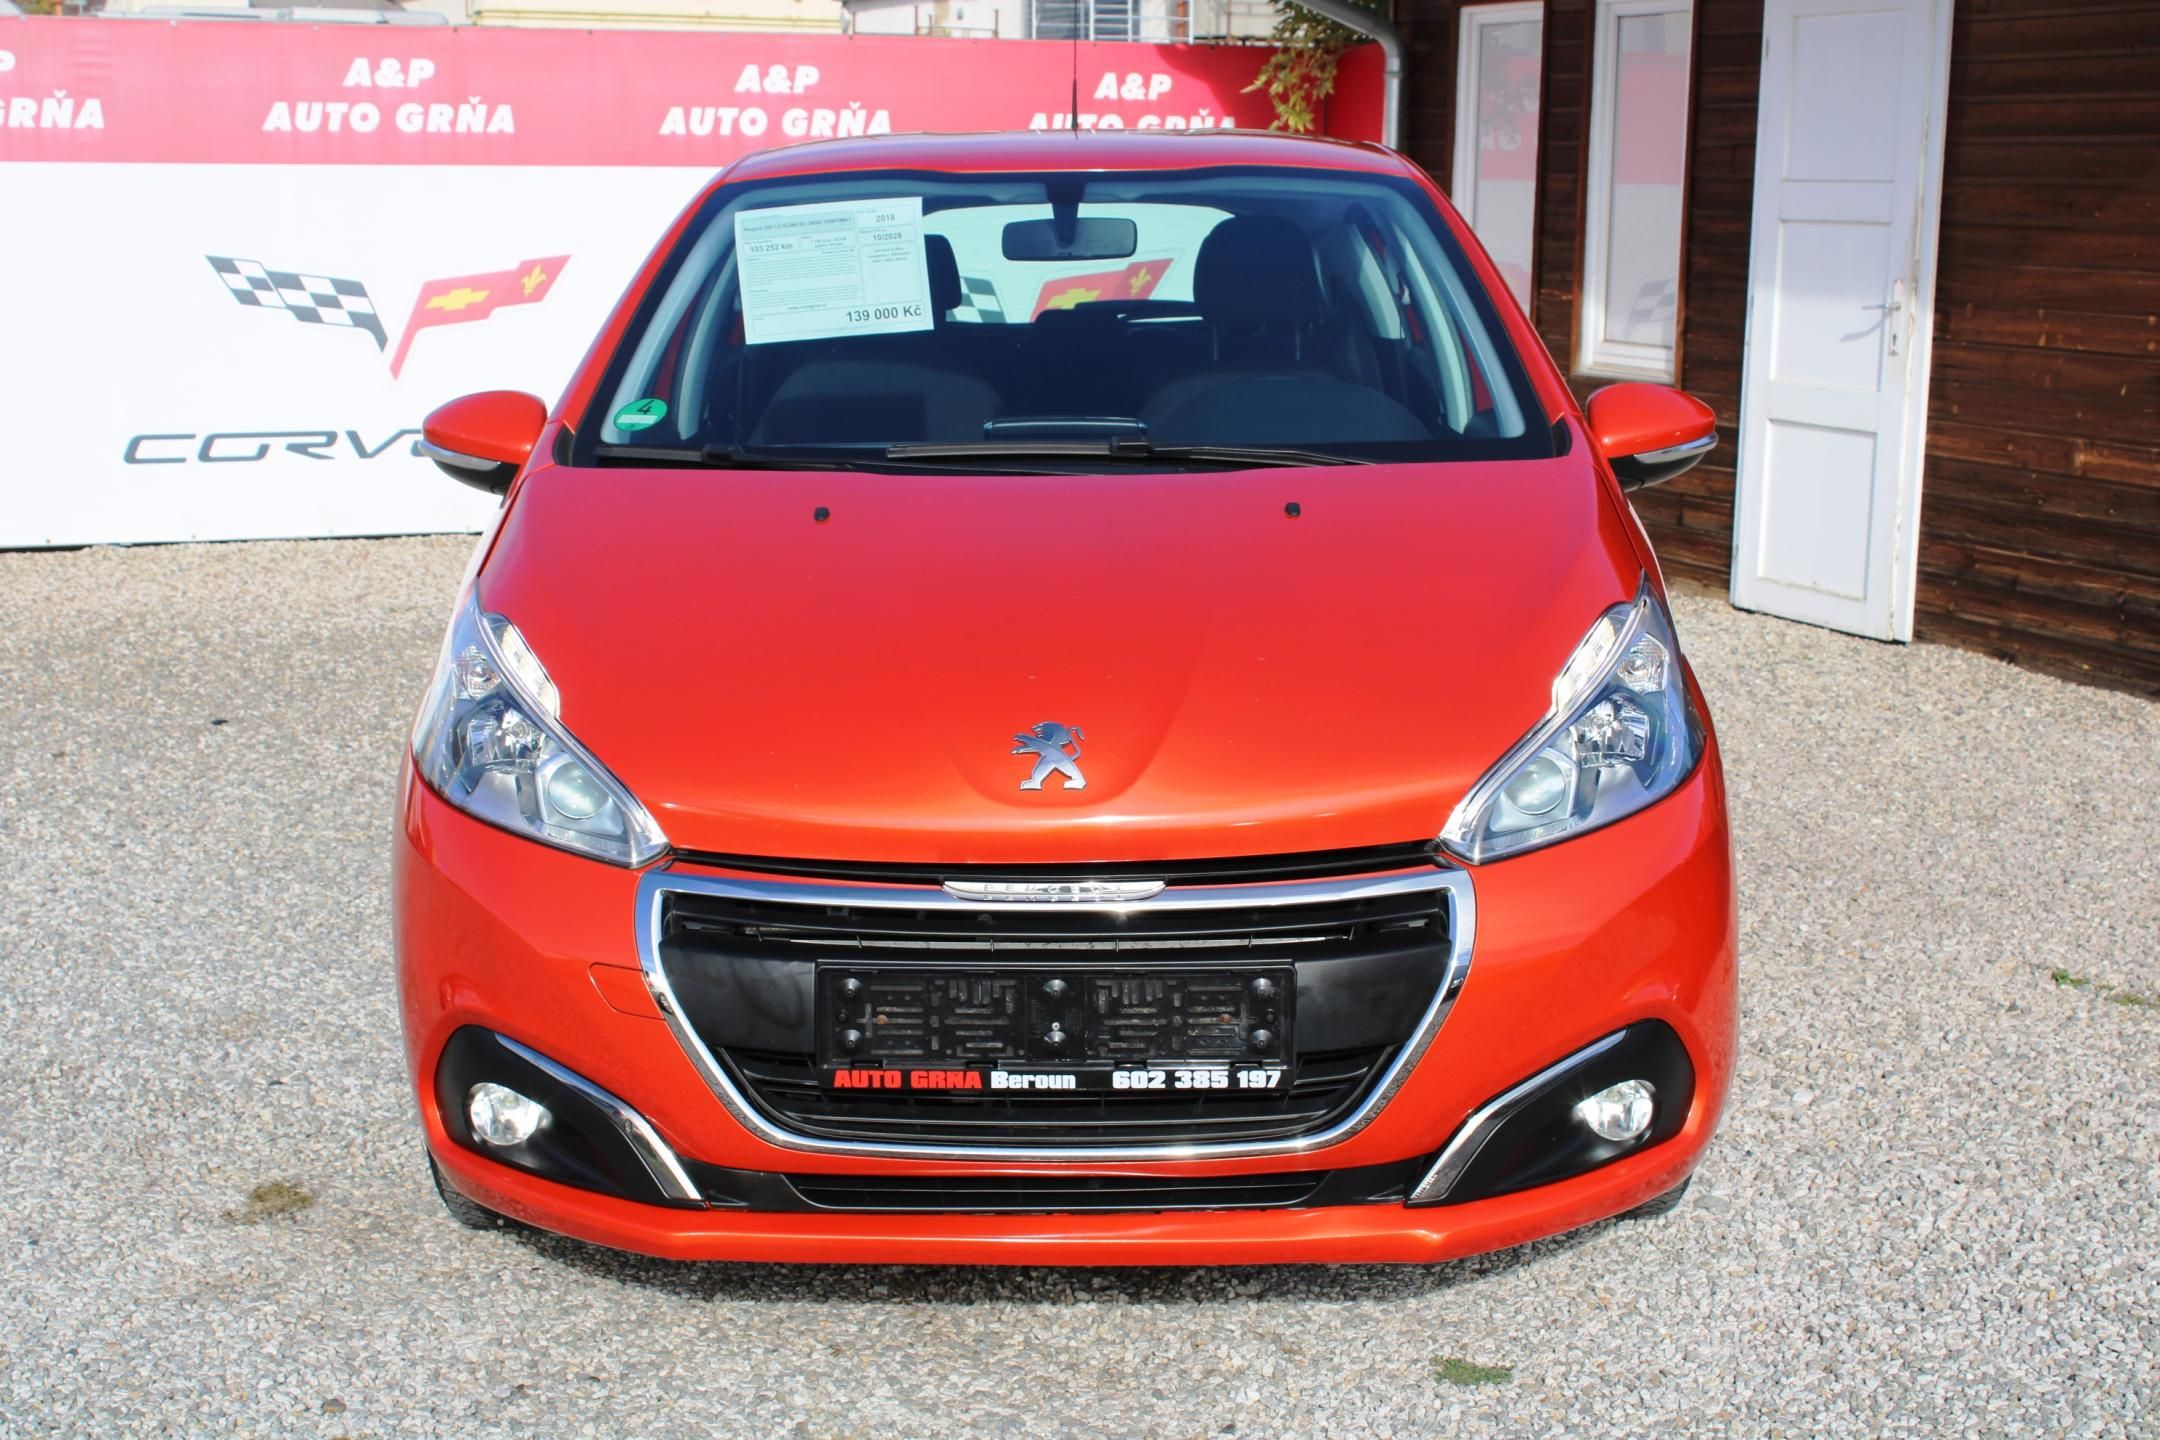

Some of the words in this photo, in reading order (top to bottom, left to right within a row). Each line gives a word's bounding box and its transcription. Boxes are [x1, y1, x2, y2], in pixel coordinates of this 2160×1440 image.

[342, 57, 436, 88] A&P
[734, 64, 820, 94] A&P
[1093, 72, 1173, 101] A&P
[0, 89, 105, 129] RŇA
[261, 101, 381, 133] AUTO
[395, 96, 515, 133] GRŇA
[658, 106, 769, 136] AUTO
[781, 101, 892, 138] GRŇA
[876, 214, 895, 223] 2018
[750, 245, 764, 253] 103
[766, 243, 779, 251] 252
[781, 242, 793, 250] km
[846, 310, 870, 323] 139
[874, 307, 899, 320] 000
[903, 304, 922, 318] Kč
[637, 399, 654, 415] 4
[833, 1070, 902, 1089] AUTO
[991, 1071, 1076, 1089] Beroun
[1112, 1070, 1166, 1089] 602
[1175, 1070, 1229, 1089] 385
[1237, 1070, 1281, 1089] 197
